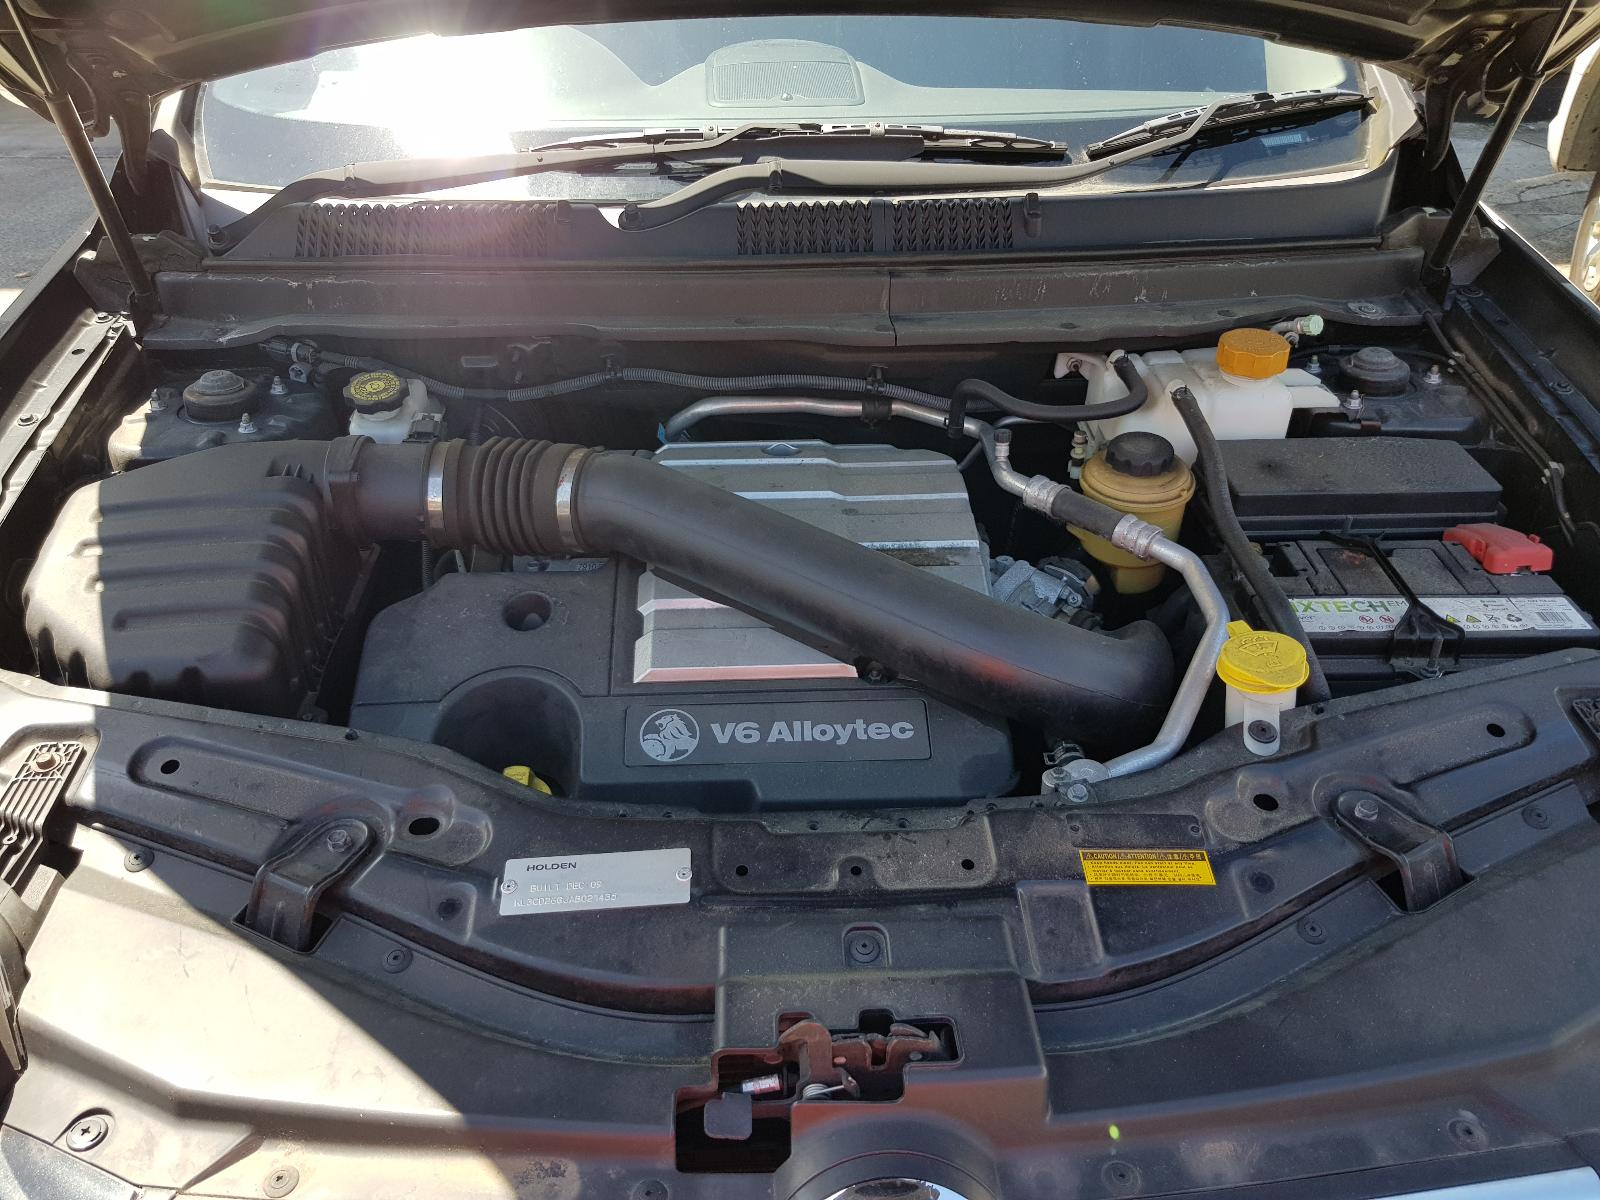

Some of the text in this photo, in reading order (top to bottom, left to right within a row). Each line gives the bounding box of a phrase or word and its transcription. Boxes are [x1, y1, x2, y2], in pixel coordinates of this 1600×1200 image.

[711, 718, 914, 745] V6 Alloytec
[526, 861, 577, 872] HOLDEN
[530, 883, 560, 893] BUILT
